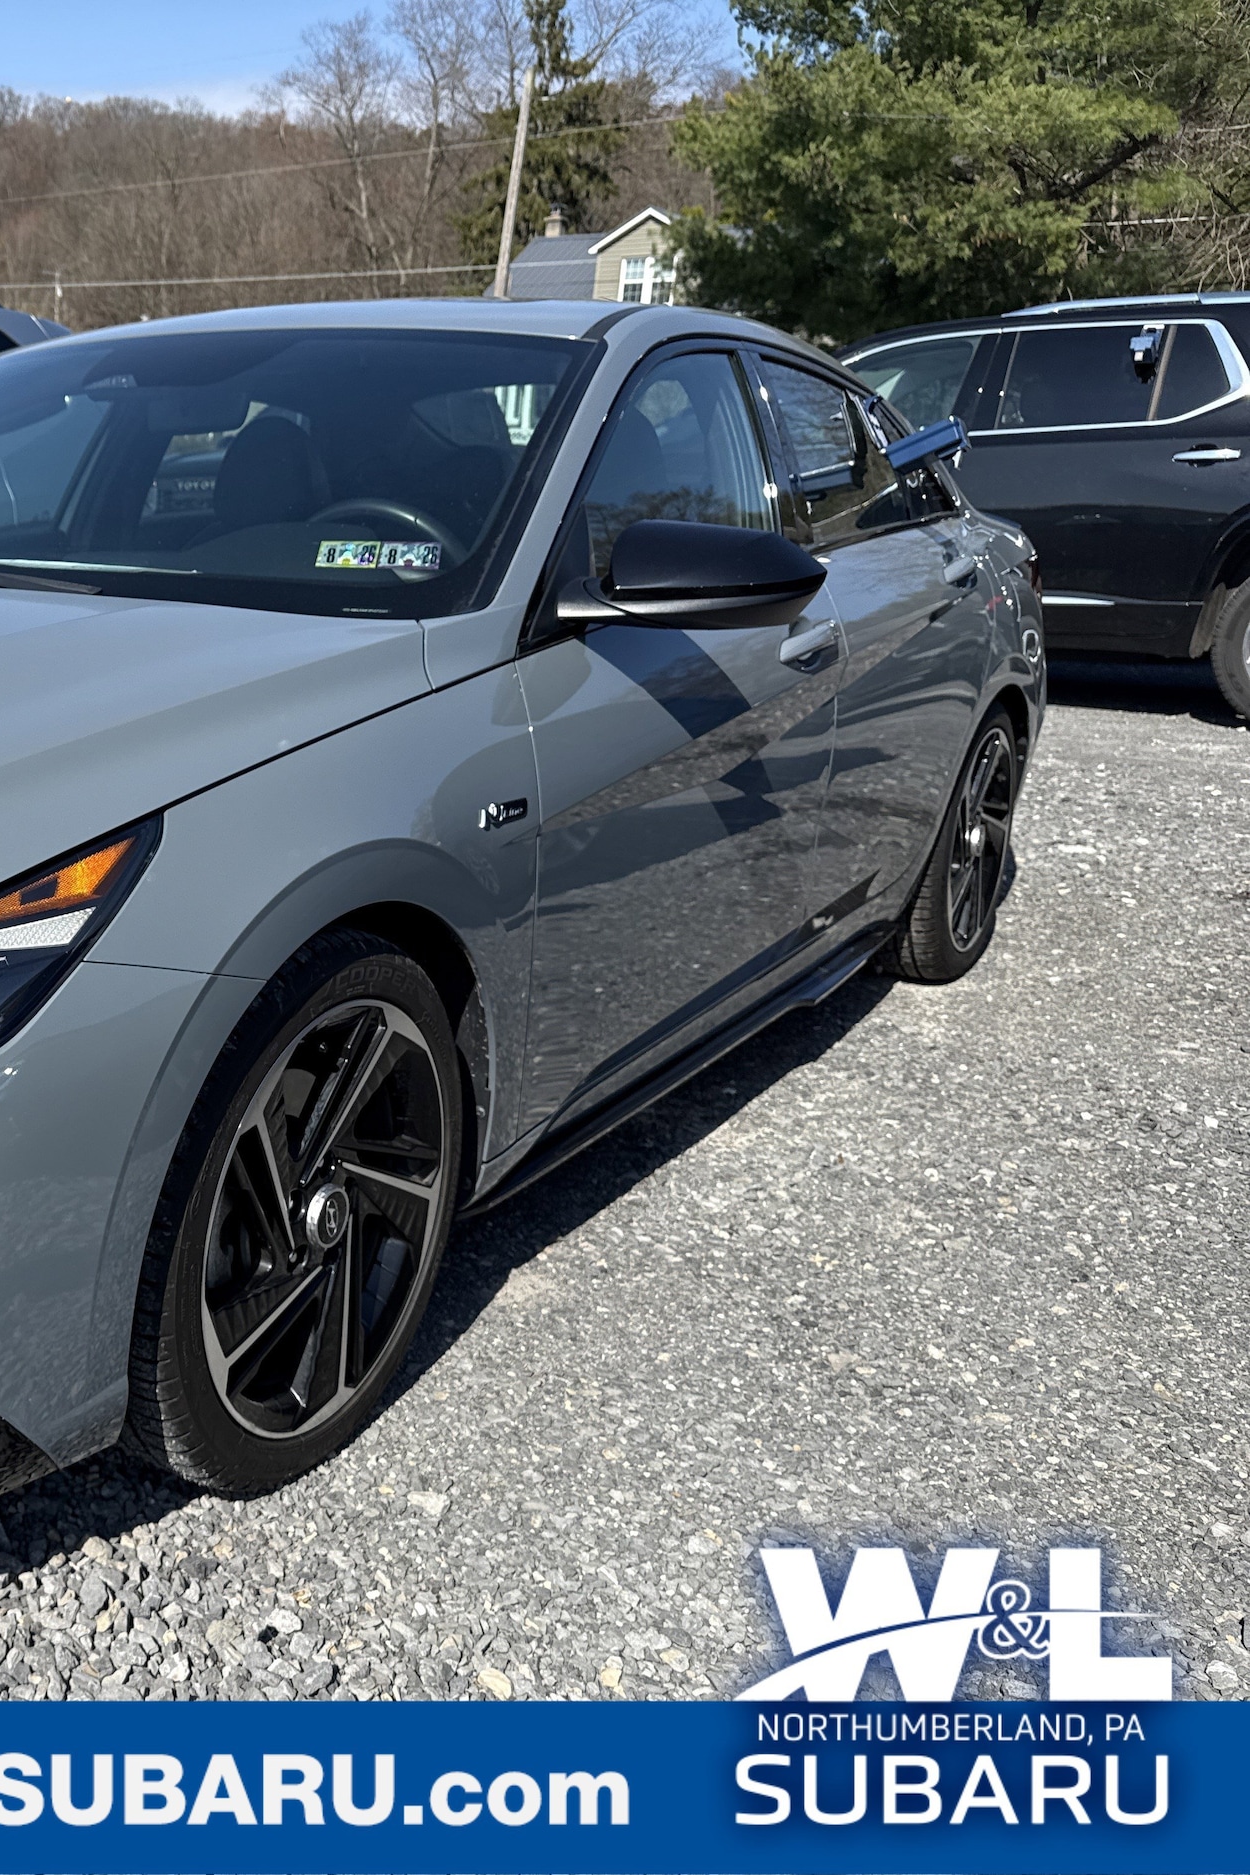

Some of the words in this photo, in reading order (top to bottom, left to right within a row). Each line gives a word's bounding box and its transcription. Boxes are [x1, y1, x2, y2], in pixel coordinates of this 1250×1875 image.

[177, 480, 216, 491] TOYOT
[326, 547, 336, 563] 8
[359, 545, 377, 564] 26
[387, 548, 398, 565] 8
[422, 546, 439, 564] 26
[335, 965, 418, 993] COOPER
